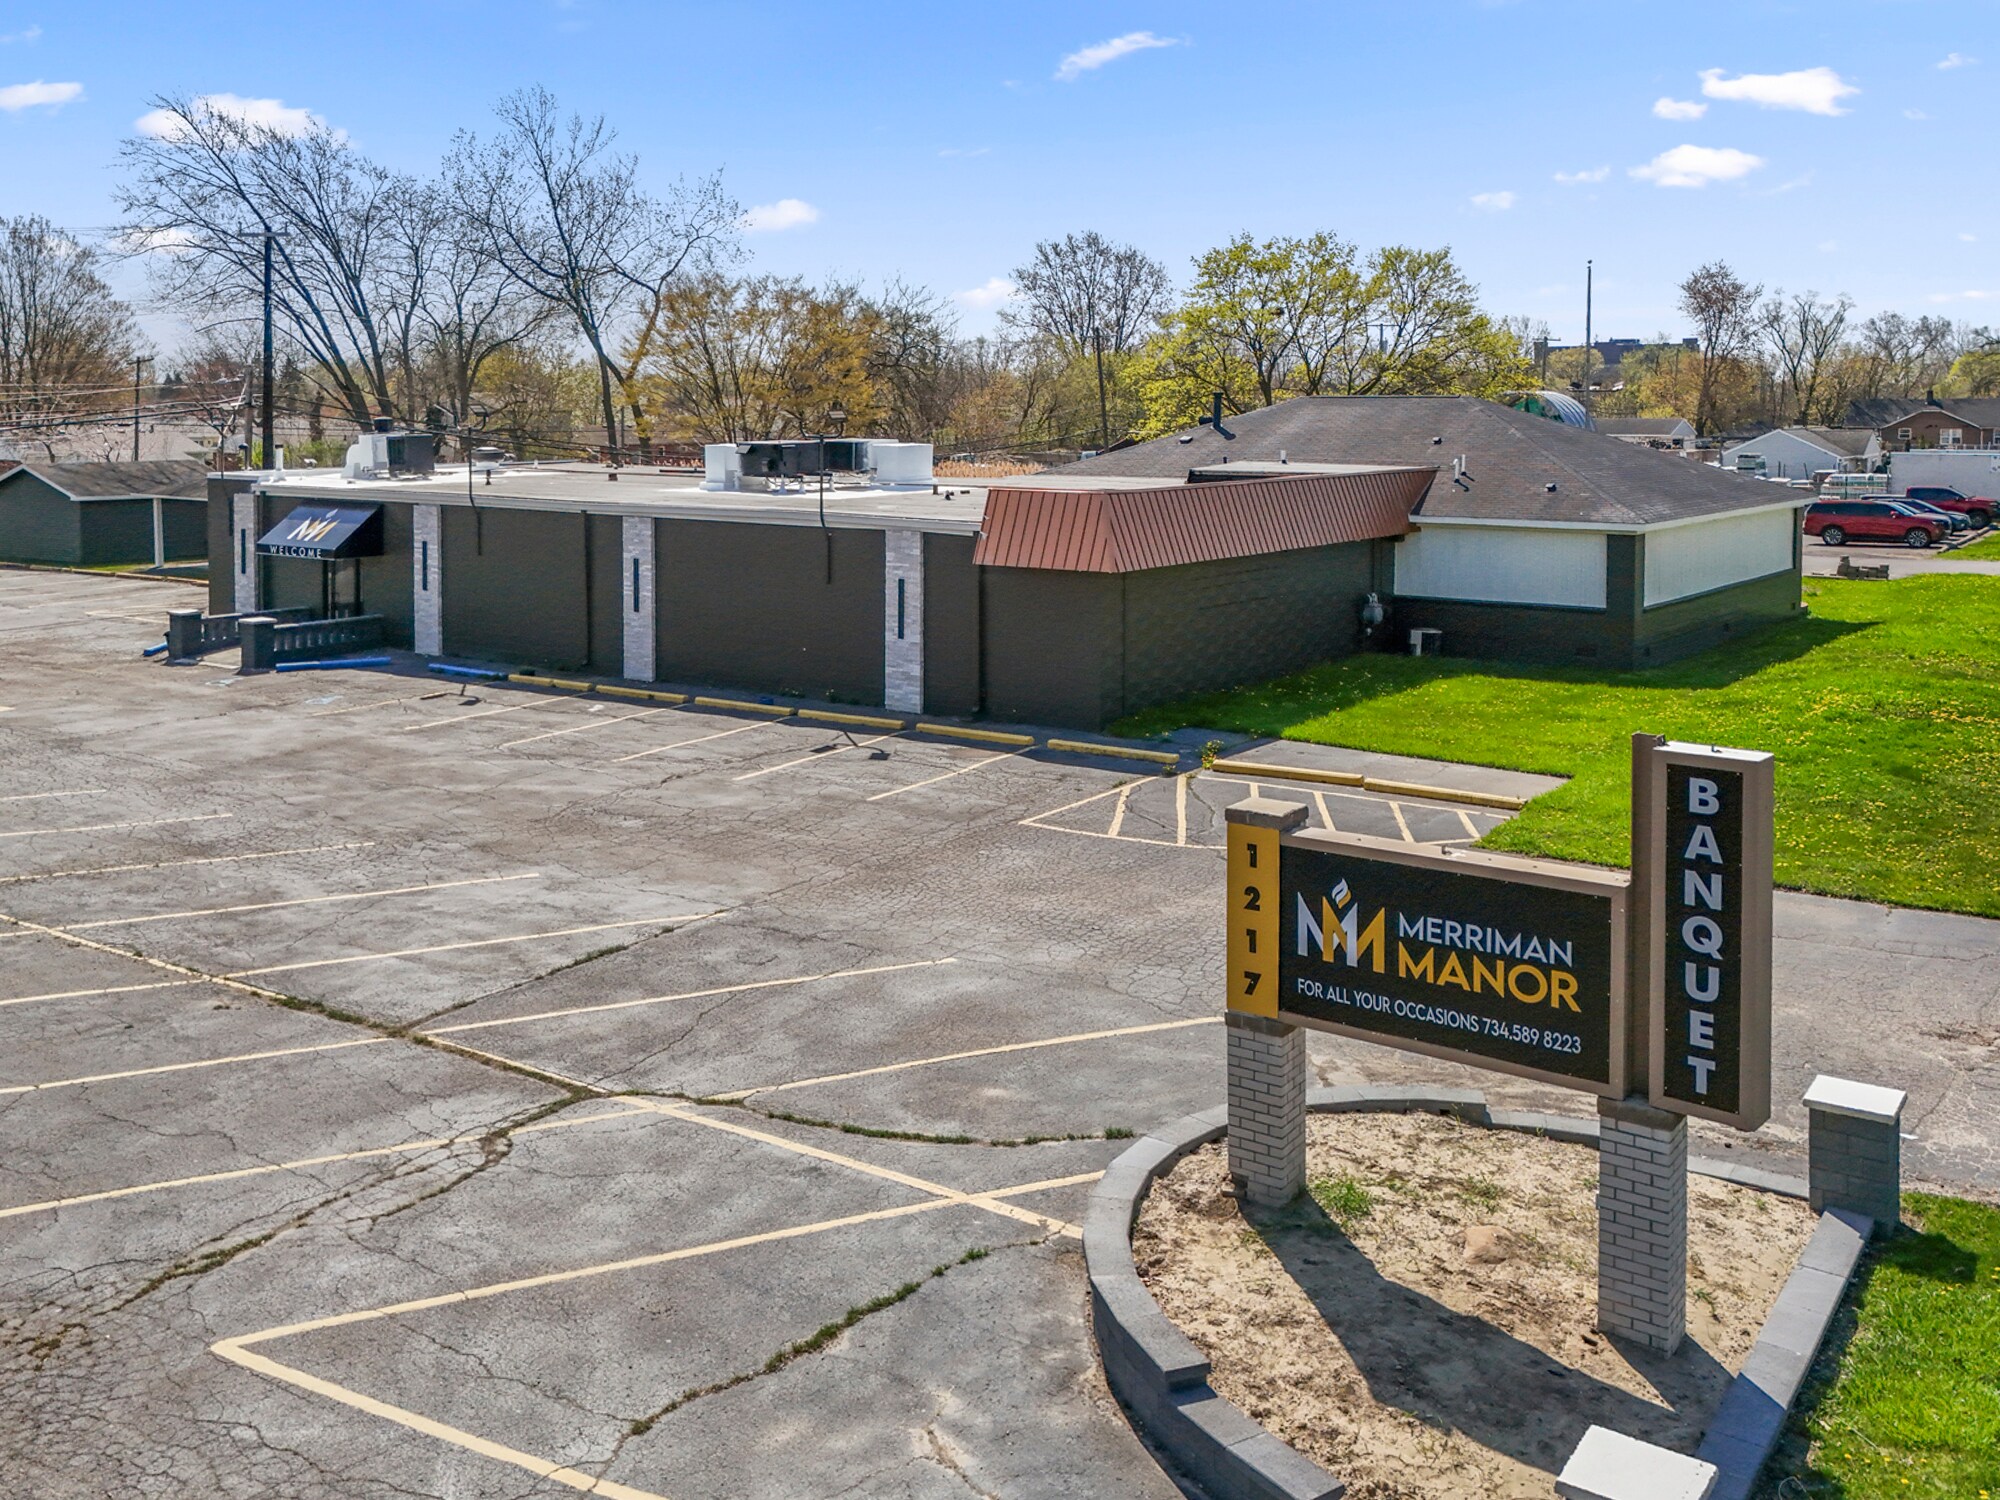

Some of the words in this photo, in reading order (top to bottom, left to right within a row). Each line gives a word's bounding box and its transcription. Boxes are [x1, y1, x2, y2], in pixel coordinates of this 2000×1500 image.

[269, 545, 322, 559] WELCOME
[1243, 843, 1262, 996] 1217
[1398, 911, 1573, 968] MERRIMAN
[1682, 777, 1723, 1095] BANQUET
[1398, 940, 1582, 1013] MANOR
[1297, 977, 1324, 999] FOR
[1326, 985, 1351, 1005] ALL
[1353, 990, 1392, 1014] YOUR
[1394, 999, 1480, 1033] OCCASIONS
[1482, 1017, 1540, 1046] 734.589
[1543, 1030, 1582, 1055] 8223
